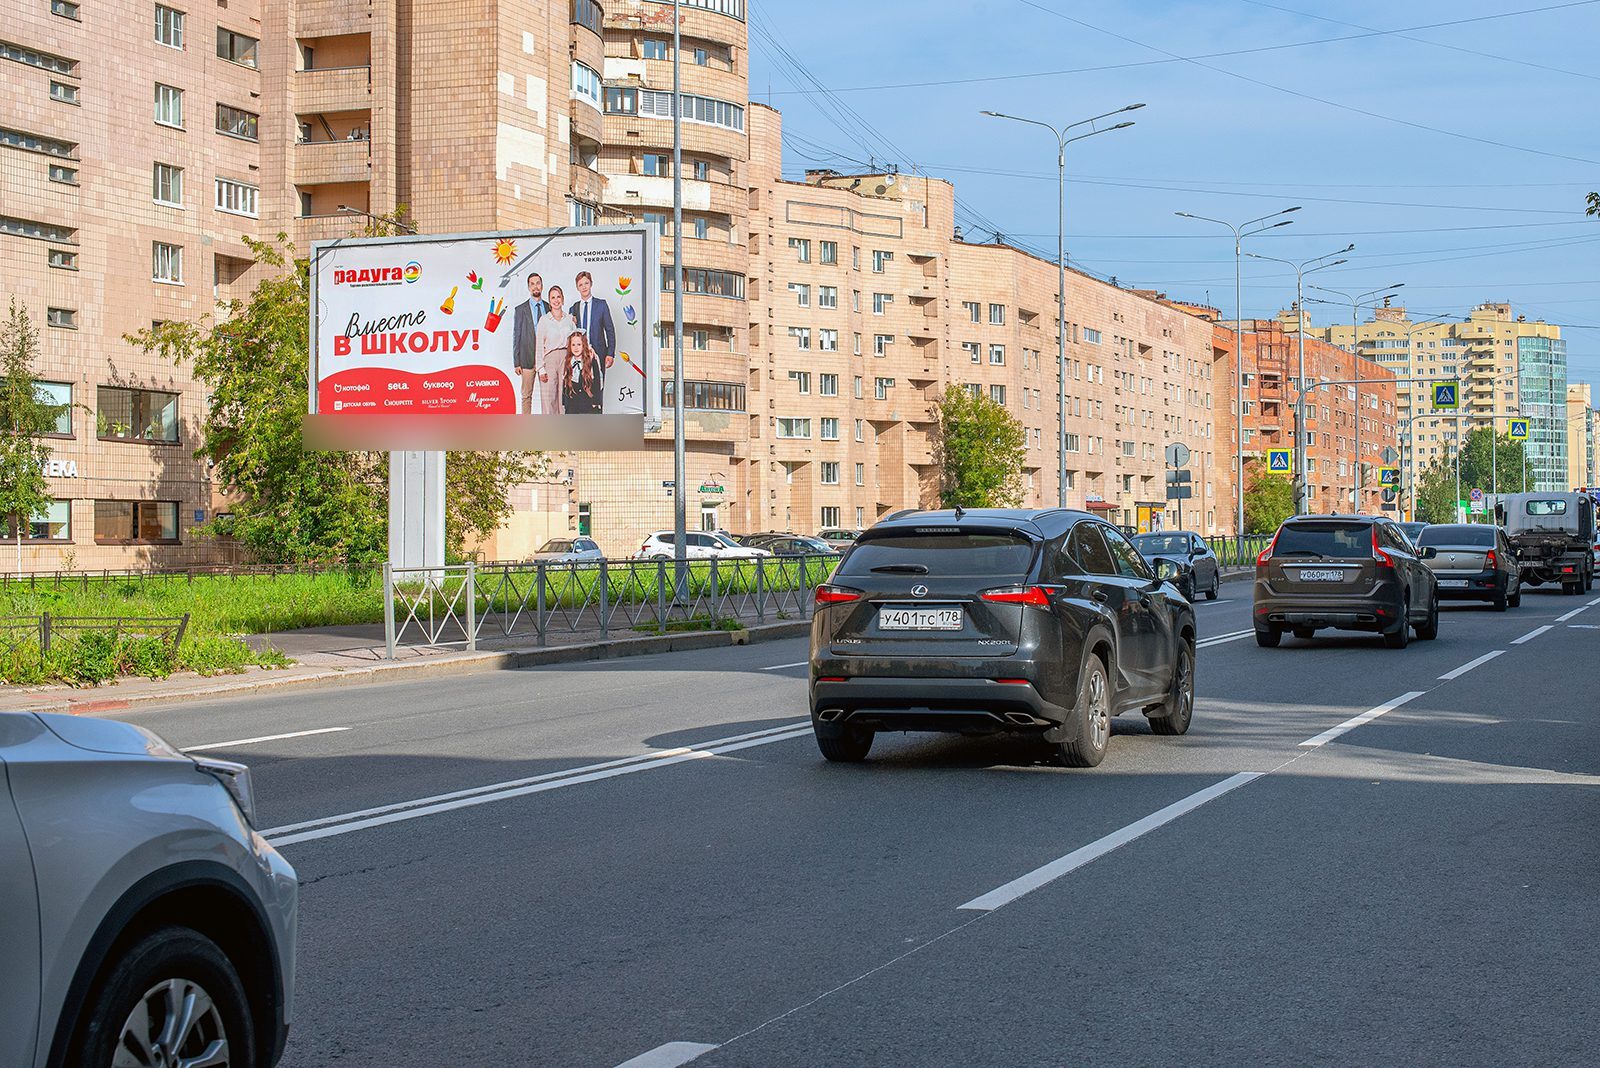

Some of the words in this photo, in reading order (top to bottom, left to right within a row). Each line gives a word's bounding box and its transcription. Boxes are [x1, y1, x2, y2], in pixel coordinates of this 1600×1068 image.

[574, 249, 624, 257] КОСМОНАВТОВ,
[333, 267, 403, 285] радуга
[345, 310, 426, 339] Вместе
[334, 335, 352, 356] В
[361, 329, 480, 355] ШКОЛУ!
[618, 386, 635, 402] 5+
[938, 611, 959, 622] 178
